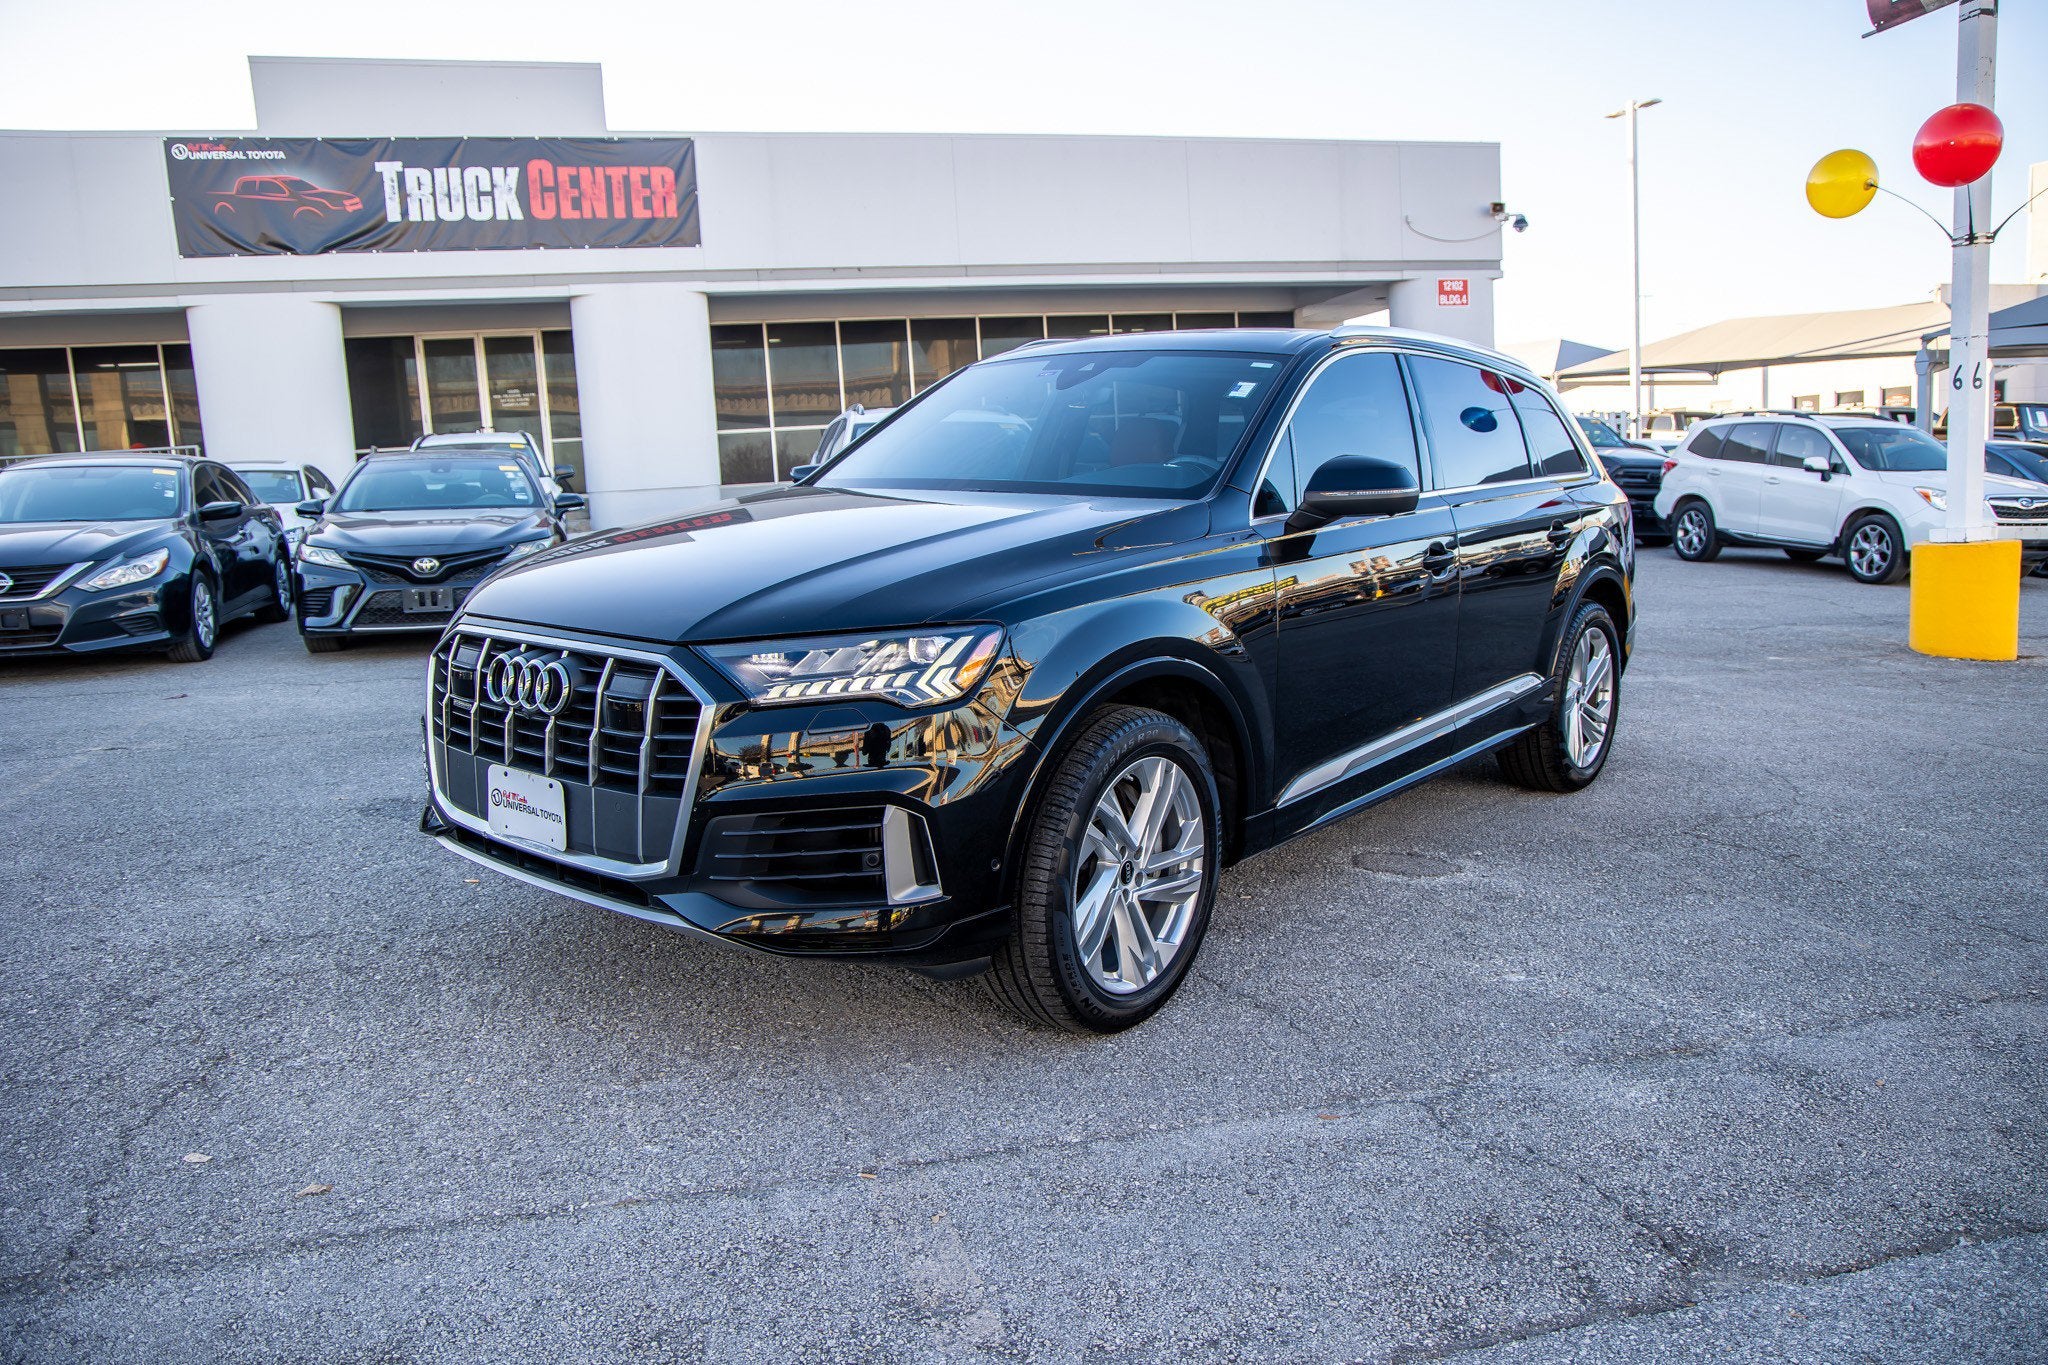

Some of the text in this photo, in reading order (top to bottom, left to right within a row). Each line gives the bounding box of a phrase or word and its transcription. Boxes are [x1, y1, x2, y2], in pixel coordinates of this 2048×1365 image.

[188, 150, 287, 160] UNIVERSAL TOYOTA
[374, 158, 679, 223] TRUCK CENTER
[503, 799, 563, 825] UNIVERSAL TOYOTA
